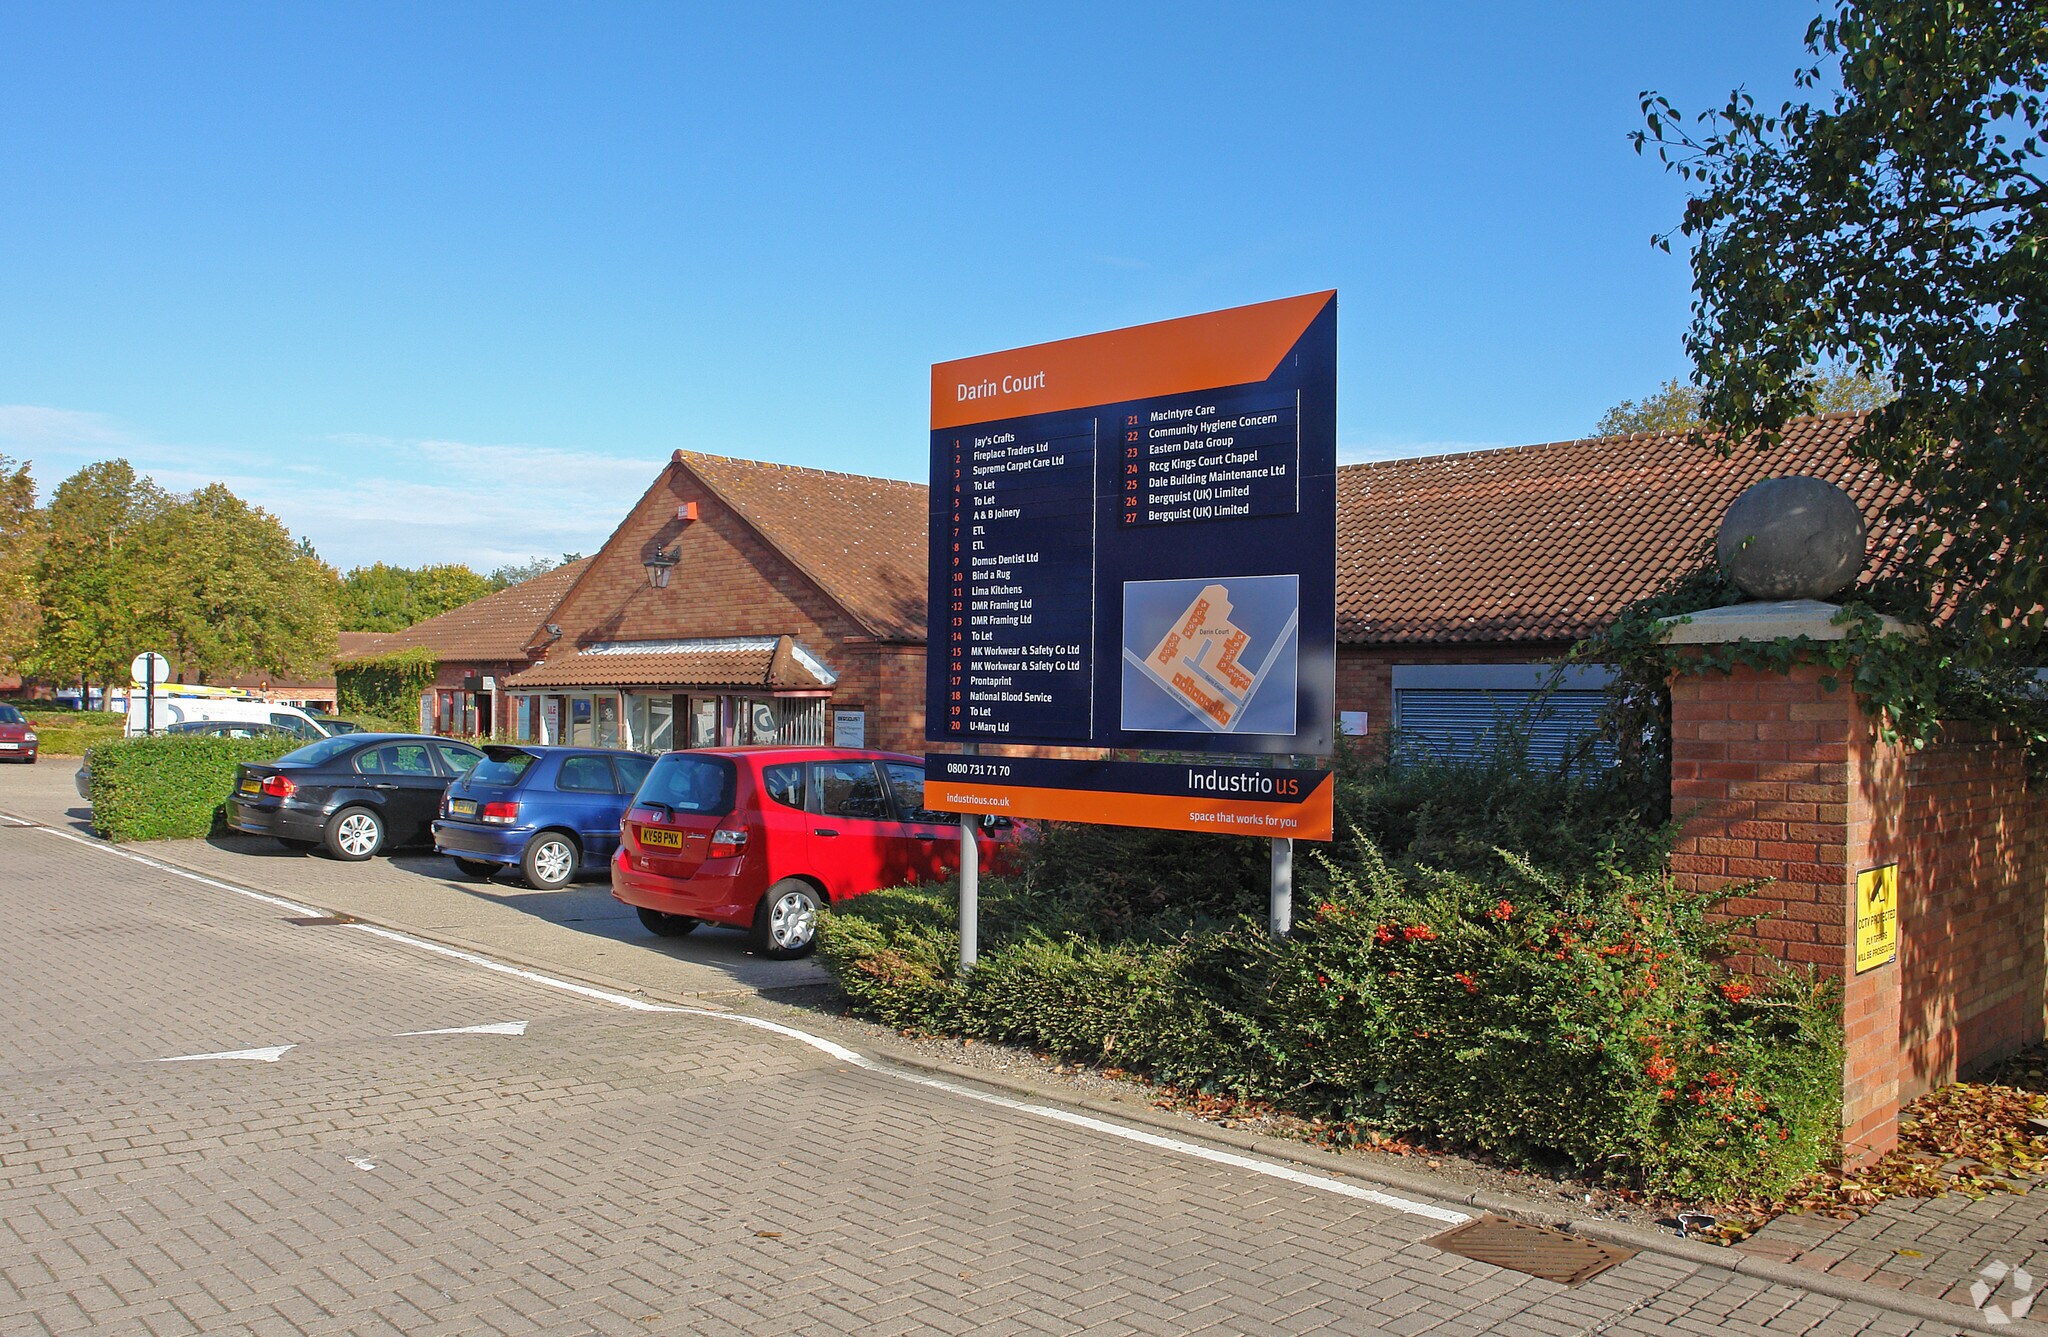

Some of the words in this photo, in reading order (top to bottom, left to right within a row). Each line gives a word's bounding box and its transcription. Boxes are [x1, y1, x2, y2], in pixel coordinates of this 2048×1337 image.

[958, 379, 997, 402] Darin
[1003, 371, 1045, 393] Court
[1128, 415, 1138, 425] 21
[1150, 408, 1193, 422] MacIntyre
[1195, 405, 1215, 416] Care
[1127, 432, 1138, 441] 22
[1149, 423, 1198, 439] Community
[1200, 418, 1237, 432] Hygiene
[1239, 414, 1277, 426] Concern
[955, 440, 960, 448] 1
[974, 436, 992, 448] Jay's
[993, 433, 1015, 443] Crafts
[1127, 448, 1138, 458] 23
[1149, 442, 1181, 455] Eastern
[1184, 439, 1204, 451] Data
[1206, 435, 1233, 448] Group
[955, 455, 960, 463] 2
[974, 449, 1005, 461] Fireplace
[1007, 445, 1034, 455] Traders
[1036, 442, 1048, 453] Ltd
[955, 470, 960, 478] 3
[973, 463, 1005, 476] Supreme
[1007, 460, 1031, 472] Carpet
[1033, 458, 1050, 468] Care
[1052, 455, 1064, 465] Ltd
[1127, 464, 1138, 474] 24
[1149, 460, 1169, 473] Rccg
[1172, 457, 1196, 471] Kings
[1198, 454, 1223, 467] Court
[1225, 450, 1258, 465] Chapel
[1127, 480, 1137, 490] 25
[1149, 477, 1168, 488] Dale
[1170, 472, 1206, 485] Building
[1209, 467, 1268, 482] Maintenance
[1270, 464, 1285, 476] Ltd
[955, 484, 960, 493] 4
[974, 482, 982, 491] To
[984, 481, 995, 490] Let
[954, 499, 959, 508] 5
[974, 497, 982, 506] To
[984, 496, 995, 505] Let
[1126, 497, 1137, 507] 26
[1149, 491, 1191, 506] Bergquist
[1193, 488, 1212, 502] (UK)
[1214, 485, 1249, 499] Limited
[954, 513, 959, 522] 6
[974, 512, 979, 520] A
[981, 511, 986, 520] &
[988, 510, 993, 519] B
[995, 508, 1020, 520] Joinery
[1126, 513, 1137, 523] 27
[1149, 508, 1191, 522] Bergquist
[1193, 505, 1212, 520] (UK)
[1214, 503, 1249, 516] Limited
[954, 528, 959, 537] 7
[973, 526, 985, 535] ETL
[954, 543, 959, 551] 8
[973, 541, 984, 550] ETL
[954, 557, 959, 566] 9
[972, 555, 997, 566] Domus
[999, 554, 1025, 564] Dentist
[1027, 553, 1038, 562] Ltd
[954, 573, 962, 581] 10
[973, 571, 988, 580] Bind
[990, 571, 994, 579] a
[997, 570, 1010, 580] Rug
[954, 588, 962, 596] 11
[972, 586, 989, 595] Lima
[991, 585, 1022, 595] Kitchens
[953, 602, 962, 611] 12
[972, 601, 988, 610] DMR
[990, 600, 1018, 611] Framing
[1020, 599, 1032, 608] Ltd
[953, 618, 962, 626] 13
[972, 616, 988, 625] DMR
[990, 615, 1018, 626] Framing
[1020, 614, 1032, 624] Ltd
[953, 632, 961, 641] 14
[972, 632, 980, 641] To
[982, 631, 992, 640] Let
[953, 648, 961, 656] 15
[971, 646, 983, 656] MK
[984, 646, 1020, 656] Workwear
[1022, 646, 1027, 655] &
[1030, 645, 1053, 657] Safety
[1055, 645, 1065, 654] Co
[1067, 645, 1079, 654] Ltd
[952, 662, 961, 671] 16
[971, 662, 983, 671] MK
[984, 662, 1020, 671] Workwear
[1022, 661, 1027, 671] &
[1030, 661, 1053, 673] Safety
[1055, 661, 1065, 670] Co
[1067, 661, 1079, 671] Ltd
[952, 677, 961, 685] 17
[971, 676, 1011, 687] Prontaprint
[952, 691, 960, 700] 18
[970, 692, 1000, 701] National
[1002, 692, 1022, 702] Blood
[1024, 693, 1052, 703] Service
[951, 706, 960, 715] 19
[970, 707, 978, 716] To
[980, 707, 991, 717] Let
[951, 721, 960, 730] 20
[970, 722, 996, 733] U-Marq
[998, 722, 1009, 732] Ltd
[948, 763, 967, 773] 0800
[970, 764, 984, 774] 731
[987, 765, 996, 775] 71
[999, 766, 1010, 776] 70
[946, 793, 1009, 806] industrious.co.uk
[1190, 812, 1214, 822] space
[1217, 812, 1234, 823] that
[1236, 815, 1262, 825] works
[1266, 815, 1278, 825] for
[1280, 819, 1296, 828] you
[664, 832, 678, 845] PNX
[1858, 916, 1869, 929] CCTV
